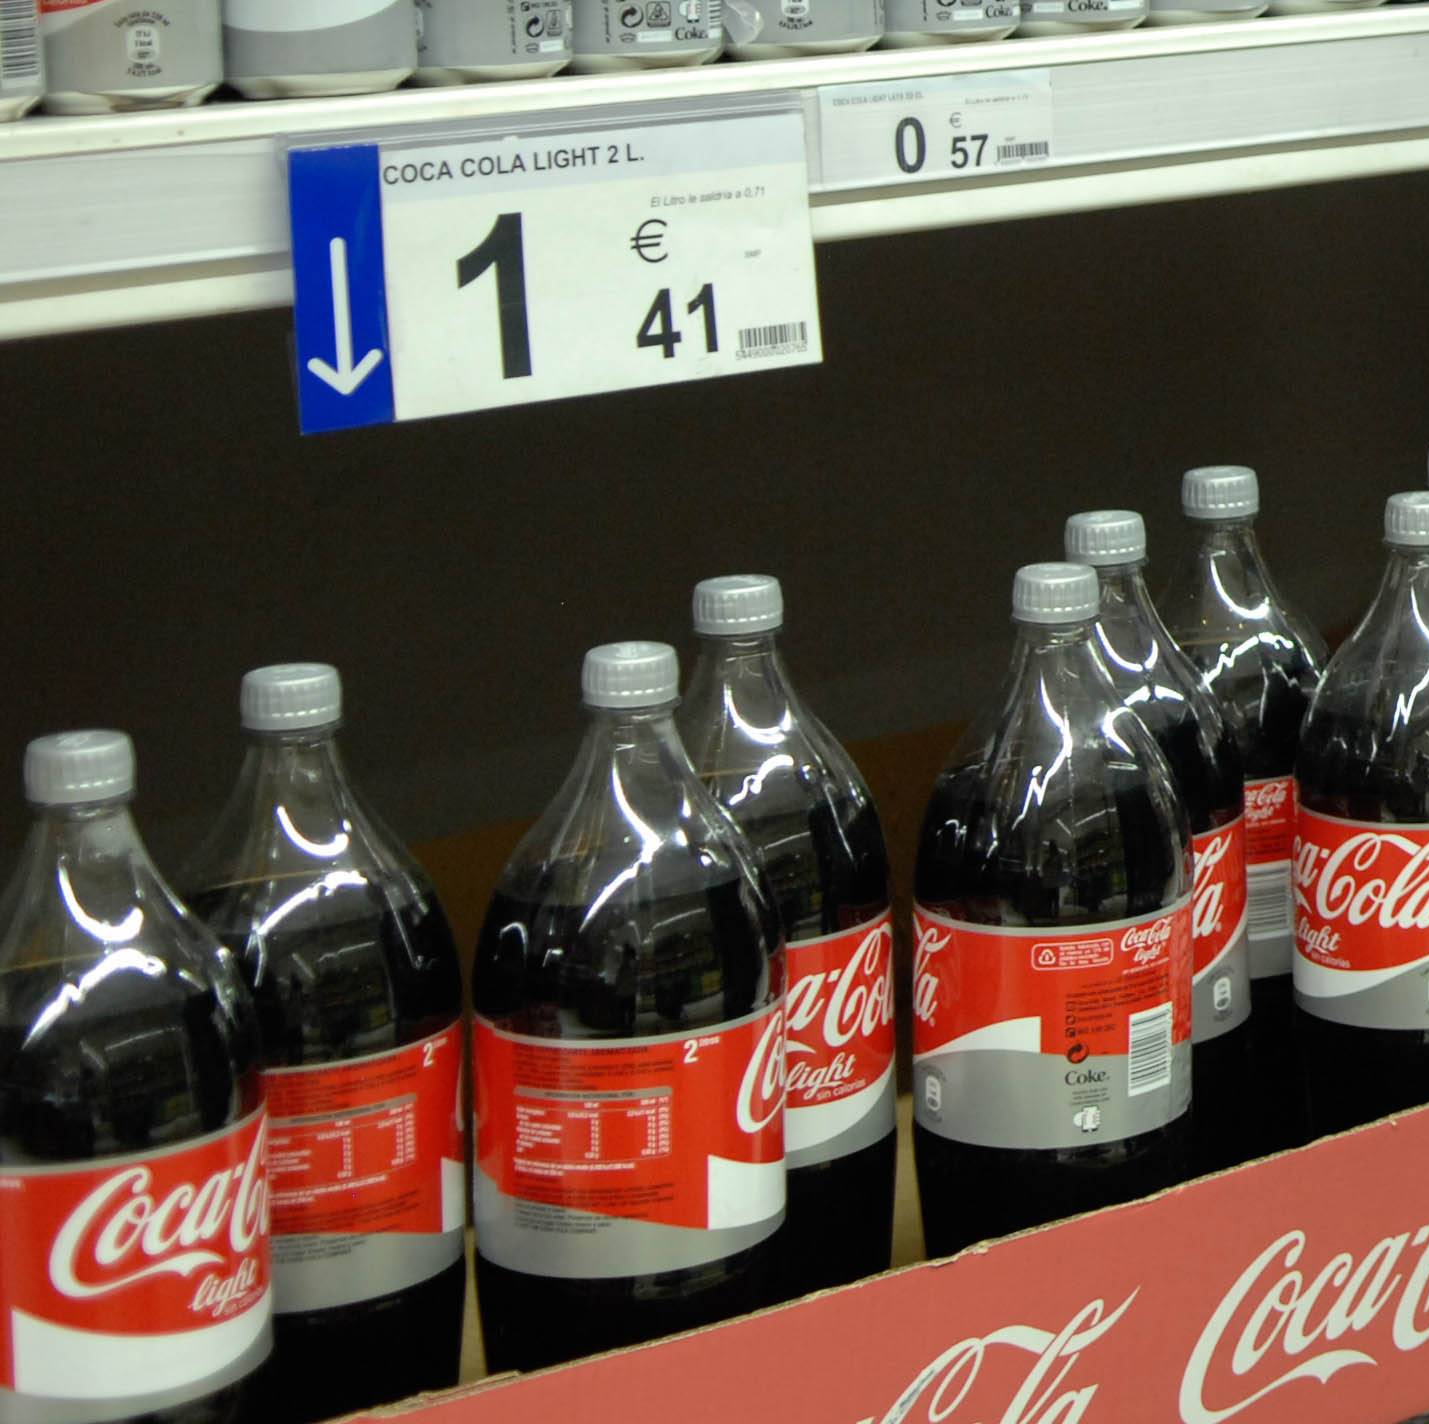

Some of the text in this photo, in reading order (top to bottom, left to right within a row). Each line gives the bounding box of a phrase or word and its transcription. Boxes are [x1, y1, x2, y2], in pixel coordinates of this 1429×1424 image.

[383, 143, 645, 185] COCA COLA LIGHT 2 L.
[895, 112, 989, 174] 0 € 57
[454, 210, 719, 380] 1 € 41
[1120, 915, 1173, 953] Coca-Cola
[422, 1041, 436, 1068] 2
[682, 1039, 699, 1065] 2
[786, 1052, 856, 1101] light
[189, 1258, 259, 1318] light
